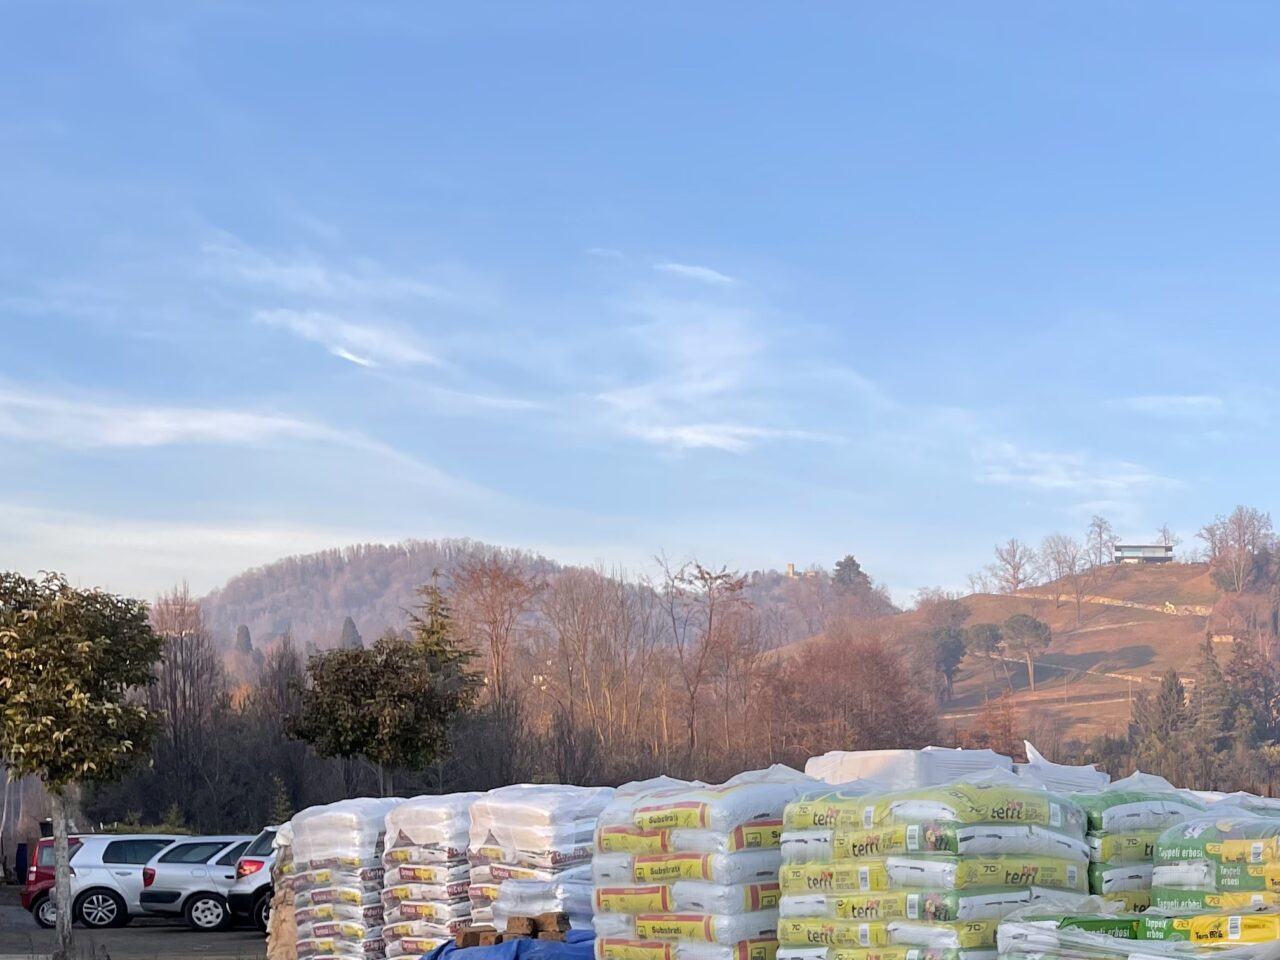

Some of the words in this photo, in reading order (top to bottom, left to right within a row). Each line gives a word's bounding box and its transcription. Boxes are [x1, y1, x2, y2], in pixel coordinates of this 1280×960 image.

[991, 806, 1022, 820] terri
[852, 839, 880, 857] terri
[1181, 847, 1203, 858] erbosi
[807, 874, 833, 890] terri
[1004, 869, 1036, 885] terri
[1221, 877, 1240, 886] erbosi
[852, 904, 880, 919] terri
[652, 926, 682, 935] Substrati
[808, 928, 835, 944] terri
[1146, 929, 1165, 939] erbosi
